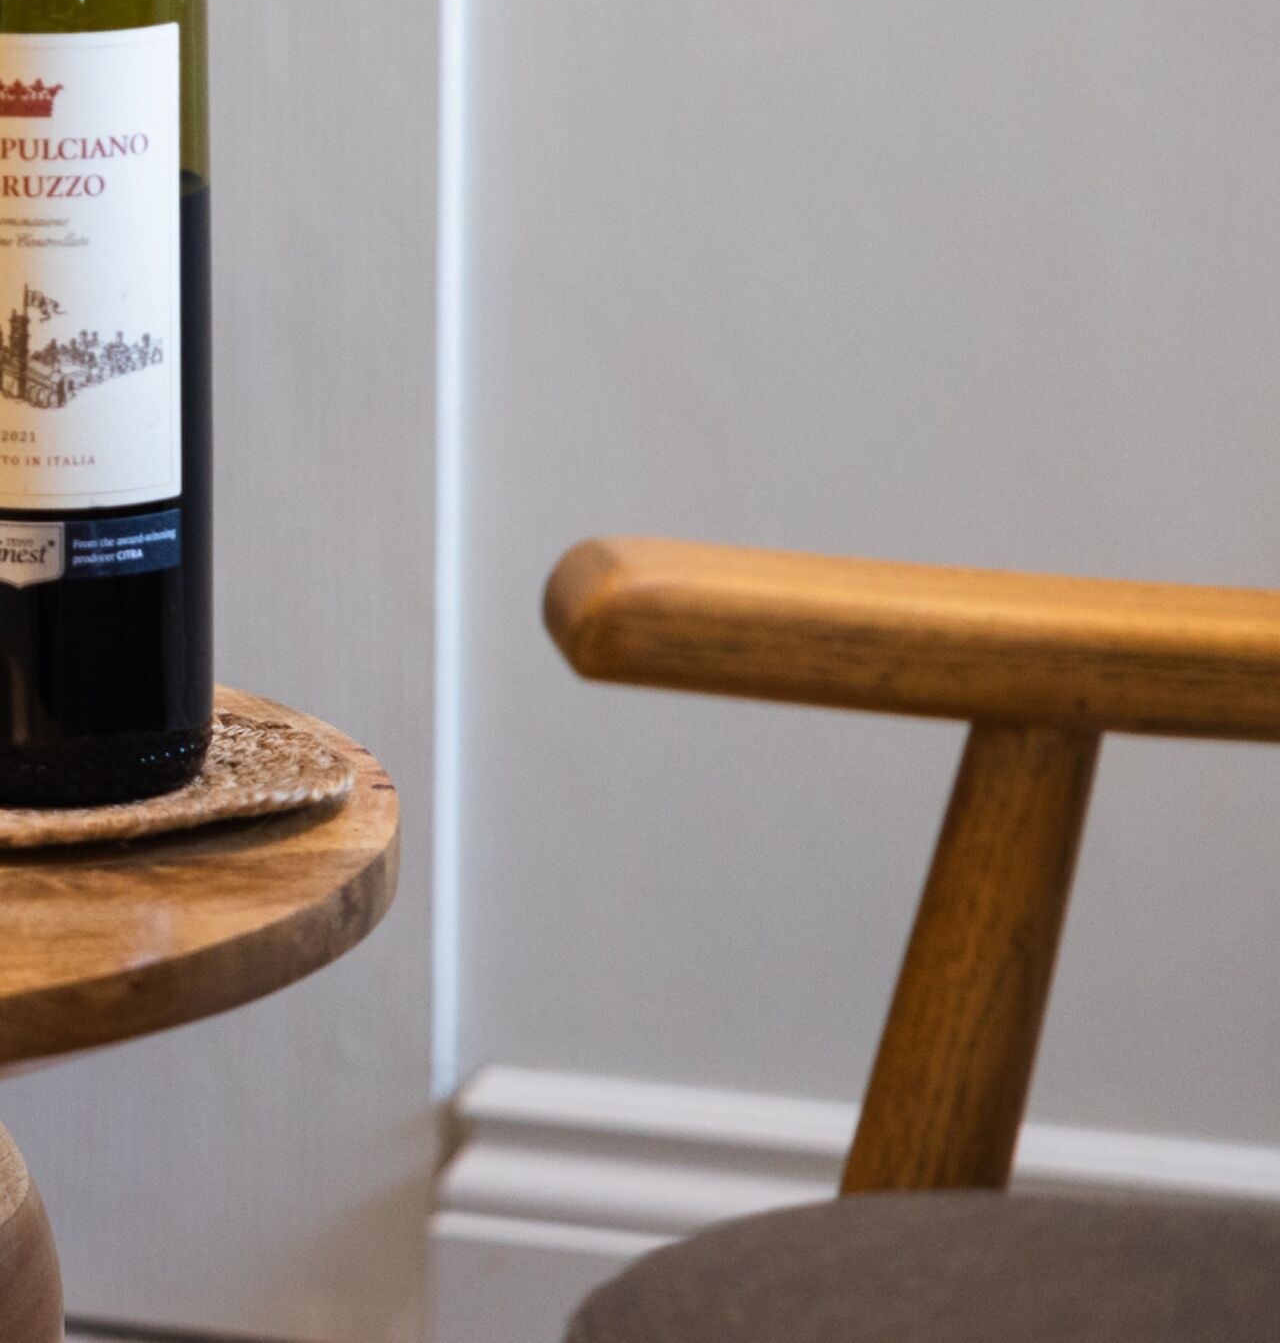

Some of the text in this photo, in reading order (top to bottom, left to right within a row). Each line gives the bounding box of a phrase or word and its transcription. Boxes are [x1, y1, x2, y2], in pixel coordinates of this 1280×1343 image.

[0, 430, 37, 443] 2021
[25, 456, 41, 467] IN
[46, 455, 96, 467] ITALIA
